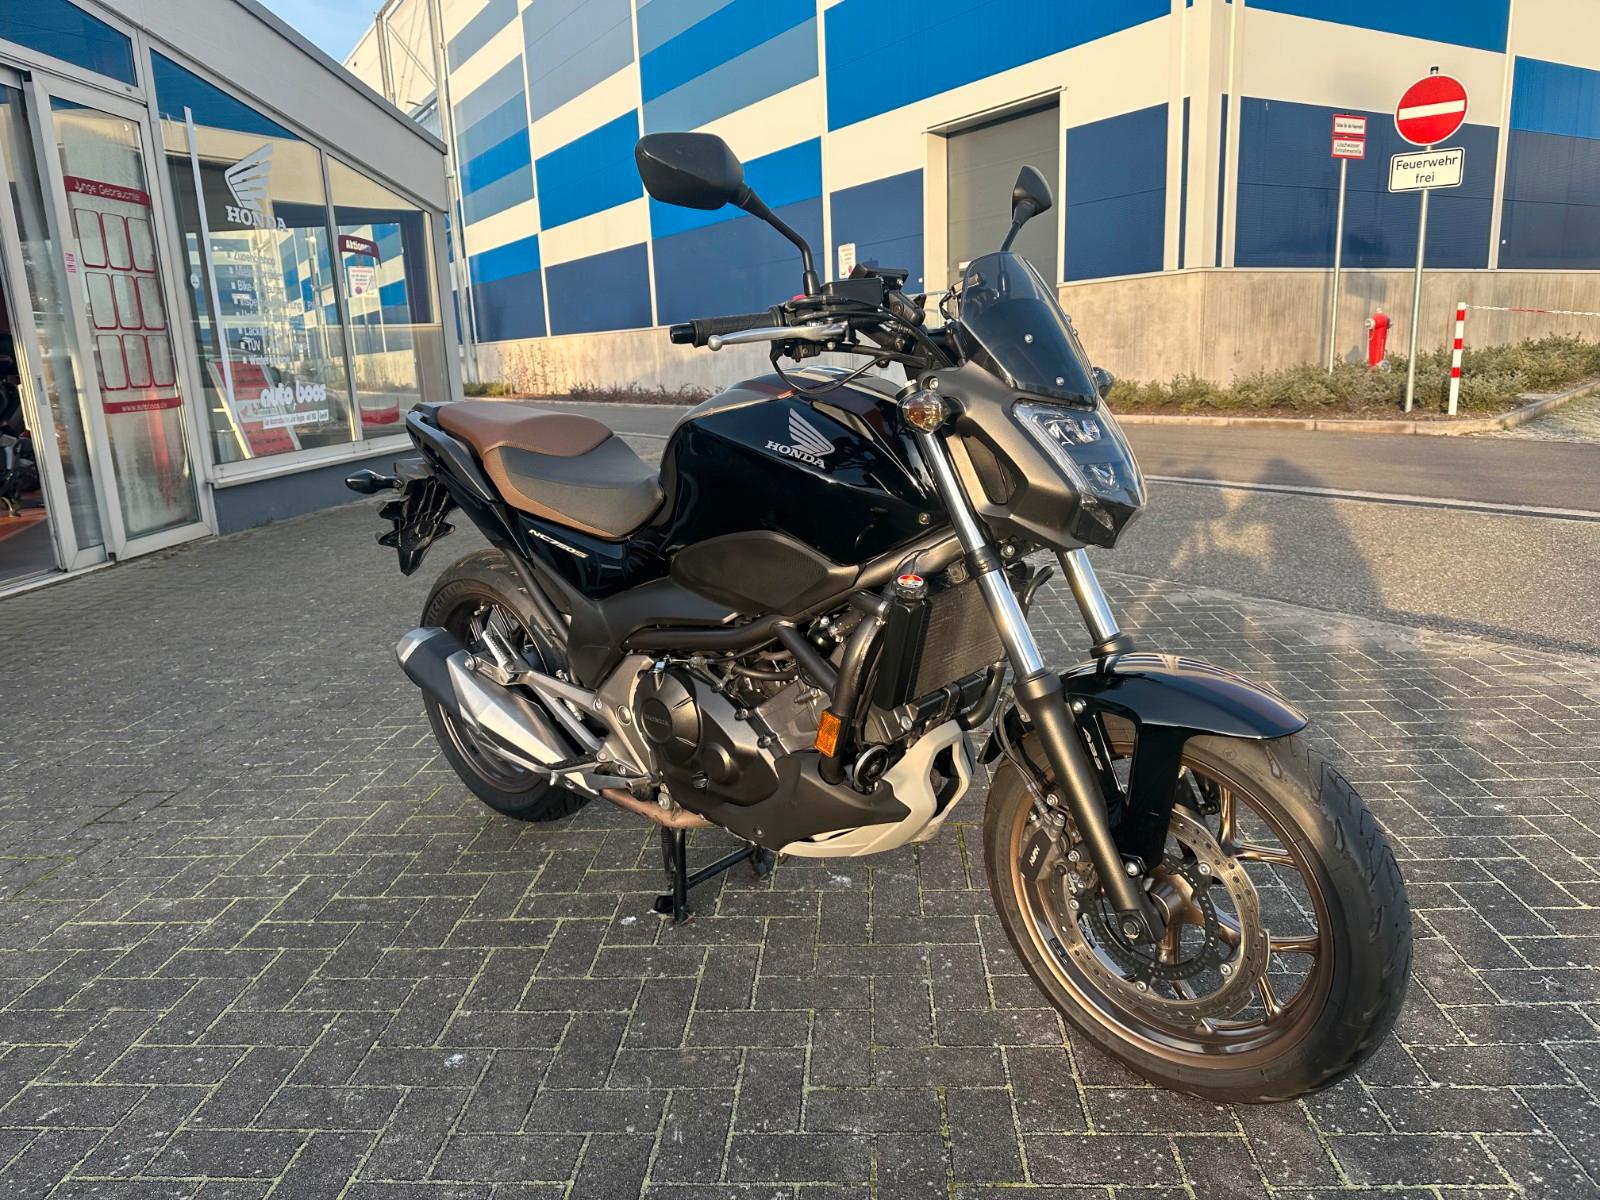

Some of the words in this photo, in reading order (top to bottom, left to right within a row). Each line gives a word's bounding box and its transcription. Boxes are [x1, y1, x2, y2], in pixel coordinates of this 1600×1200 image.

[1396, 155, 1458, 171] Feuerwehr
[1415, 172, 1435, 184] frei
[225, 205, 289, 232] HONDA
[260, 382, 294, 408] auto
[295, 379, 327, 404] boos
[764, 440, 826, 470] HONDA
